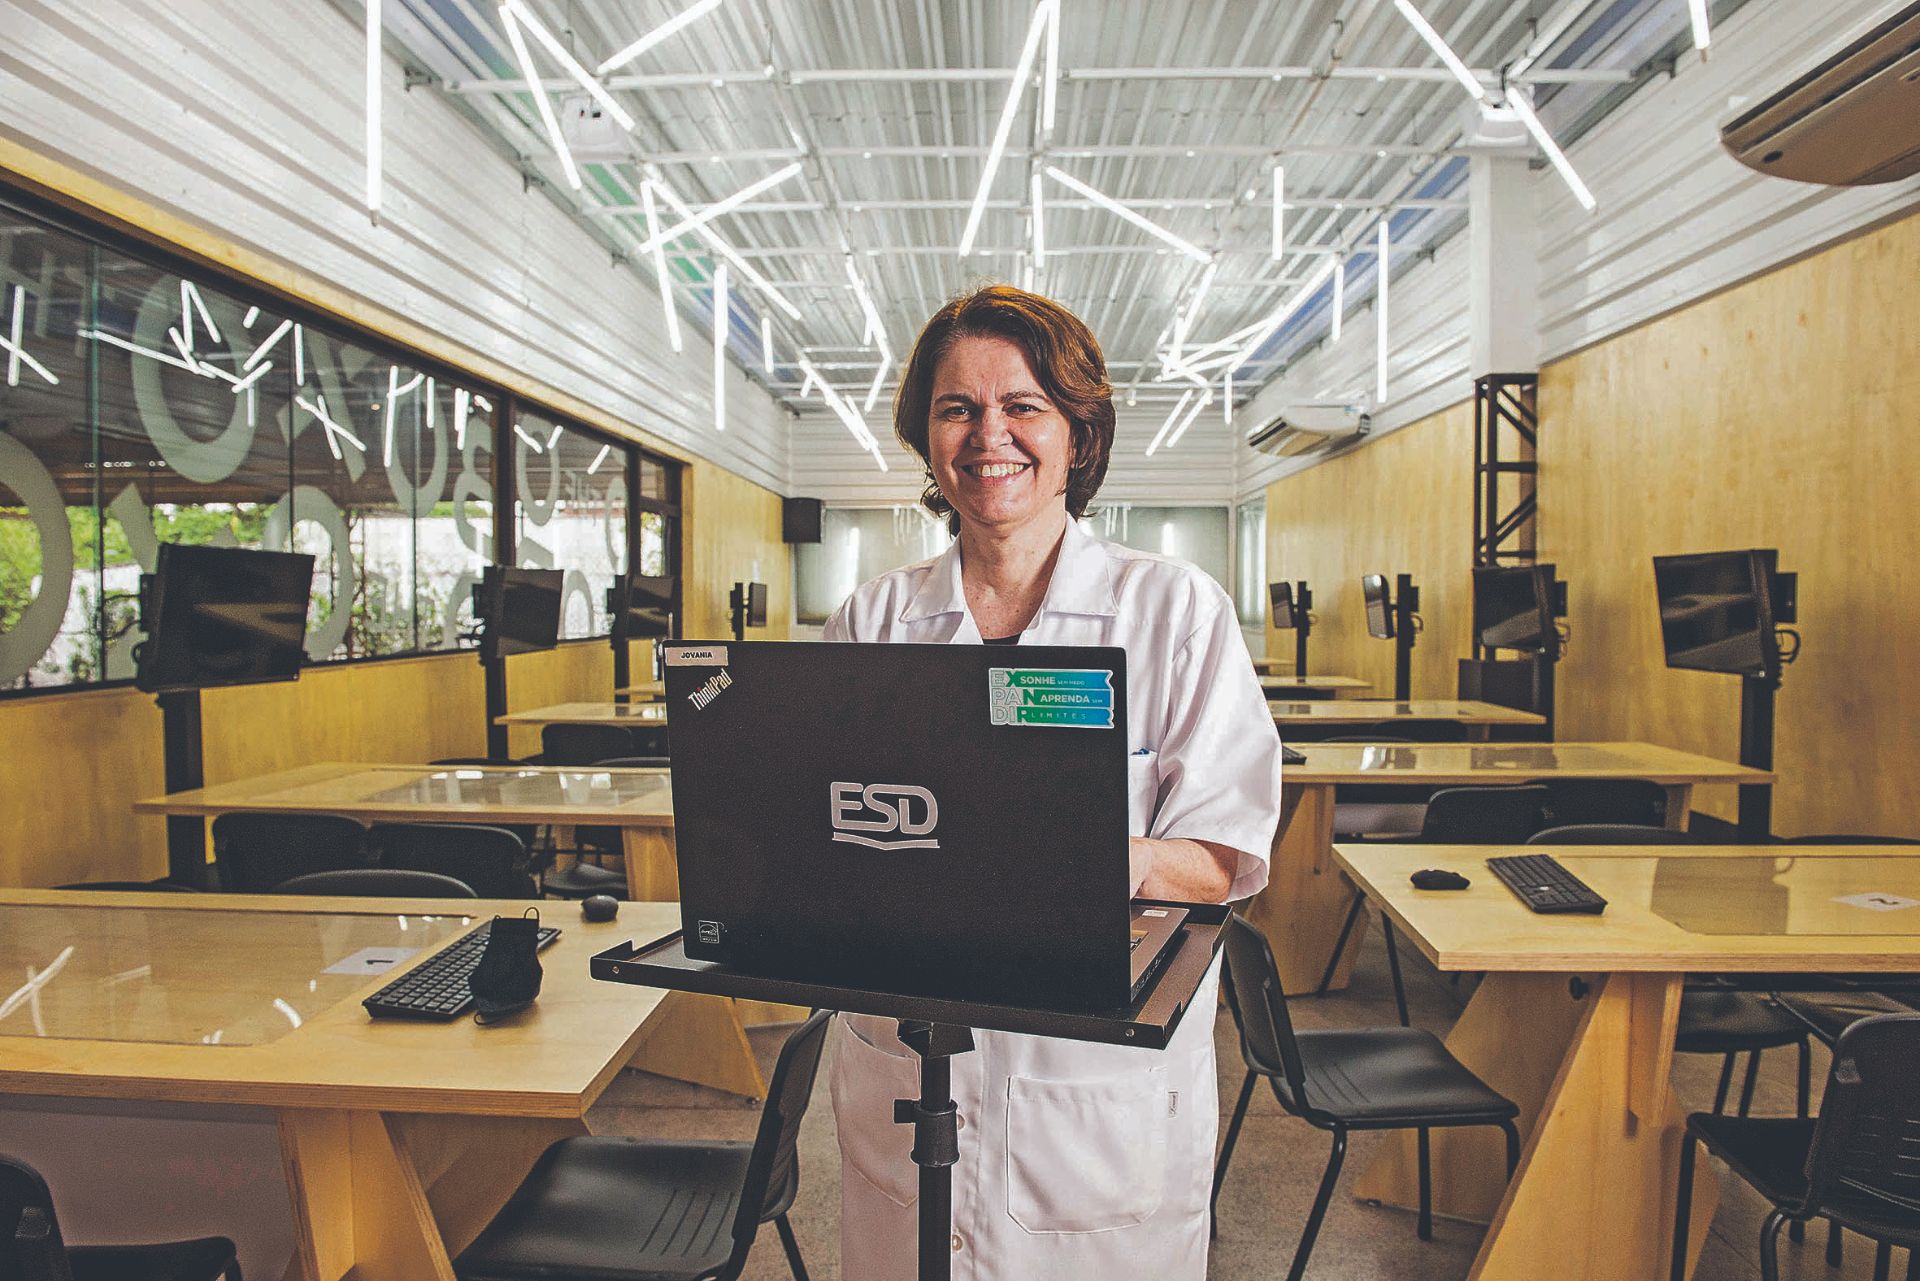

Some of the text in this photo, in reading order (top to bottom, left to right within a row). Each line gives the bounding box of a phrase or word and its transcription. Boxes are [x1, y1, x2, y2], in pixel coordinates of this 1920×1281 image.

[681, 651, 713, 659] JOVANIA
[1020, 676, 1056, 685] SONHE
[688, 667, 733, 711] ThinkPad
[1040, 694, 1090, 703] APRENDA
[1031, 712, 1087, 720] LIMITES
[830, 781, 938, 835] ESD
